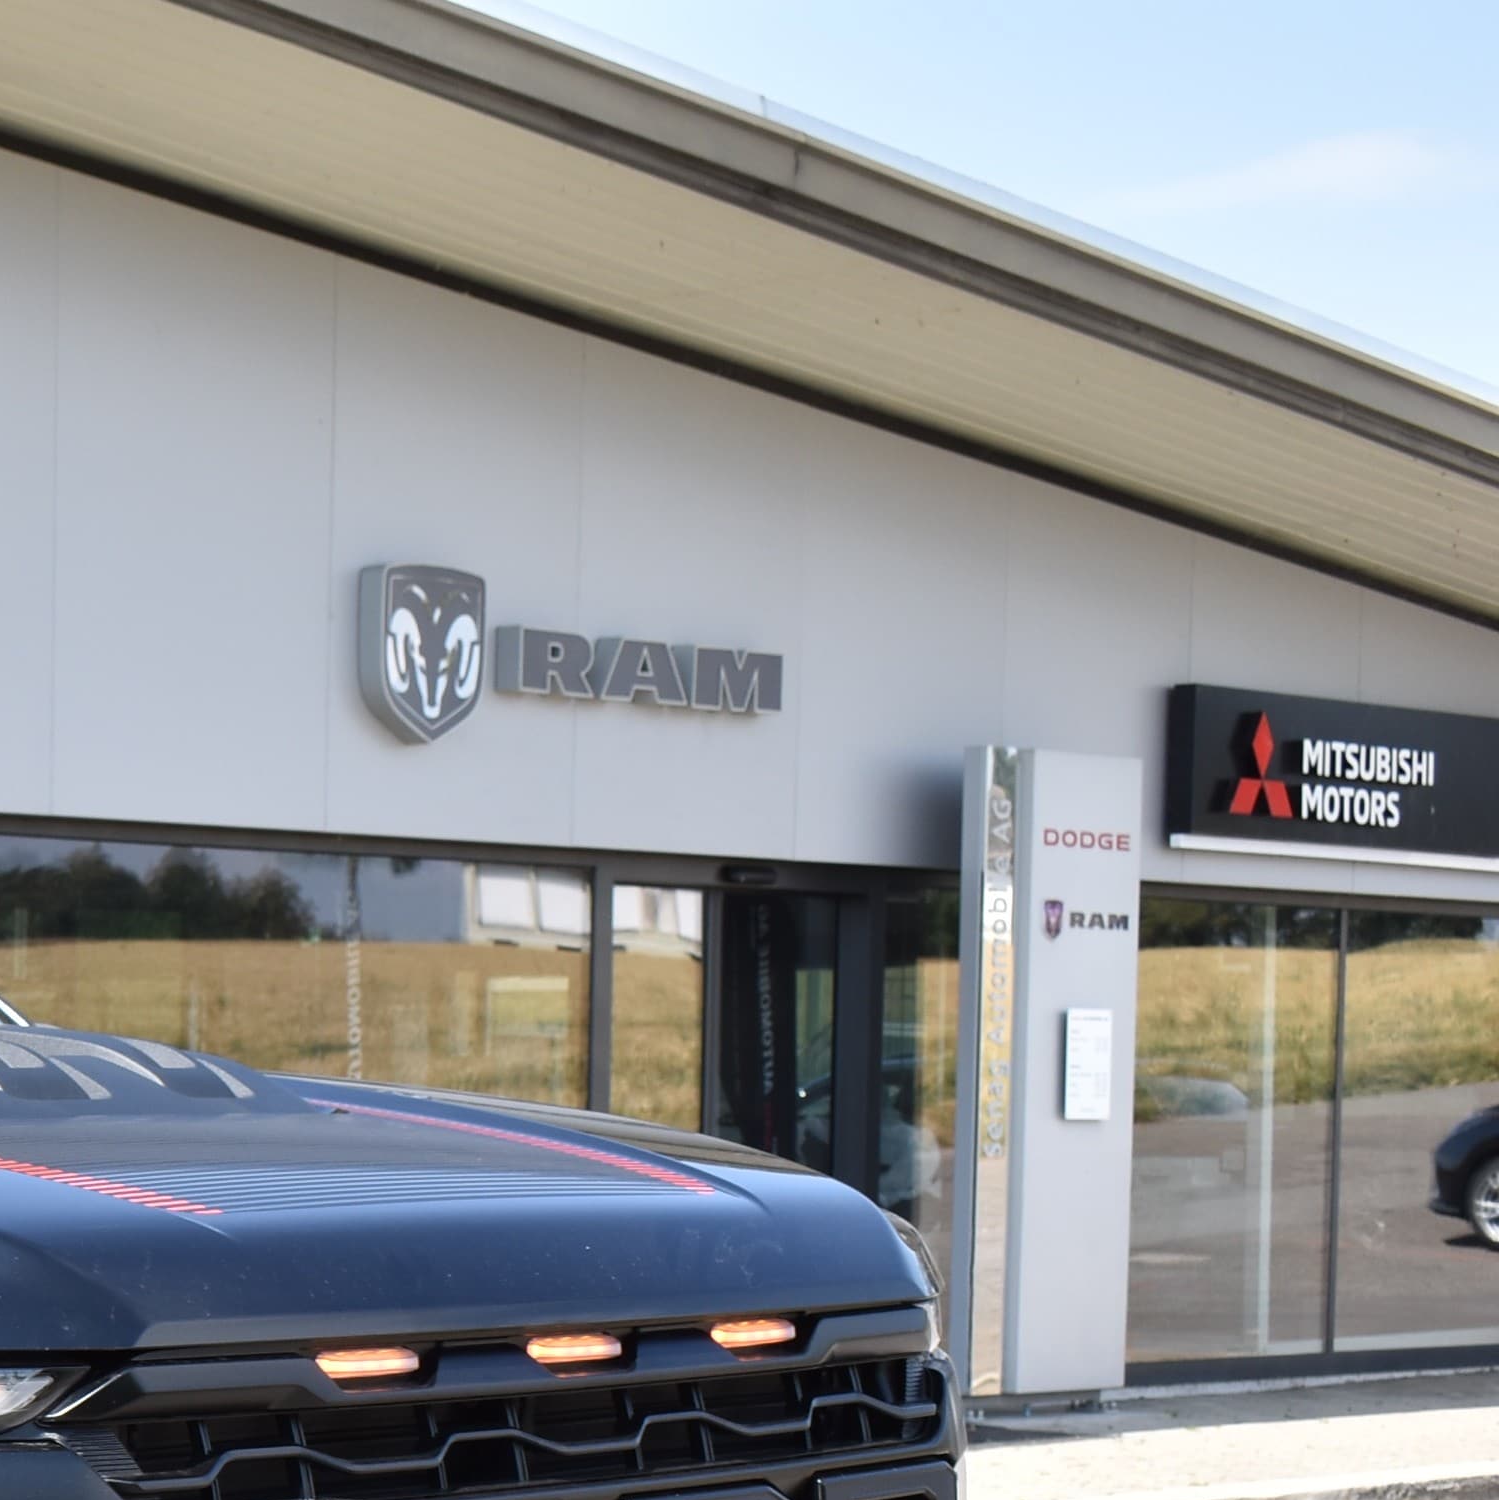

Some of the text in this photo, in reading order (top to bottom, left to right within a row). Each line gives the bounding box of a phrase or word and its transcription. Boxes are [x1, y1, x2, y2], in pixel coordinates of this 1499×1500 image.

[495, 624, 784, 714] RAM
[1301, 737, 1436, 787] MITSUBISHI
[991, 799, 1013, 844] AG
[1300, 782, 1401, 829] MOTORS
[1043, 828, 1132, 852] DODGE
[1069, 911, 1130, 931] RAM
